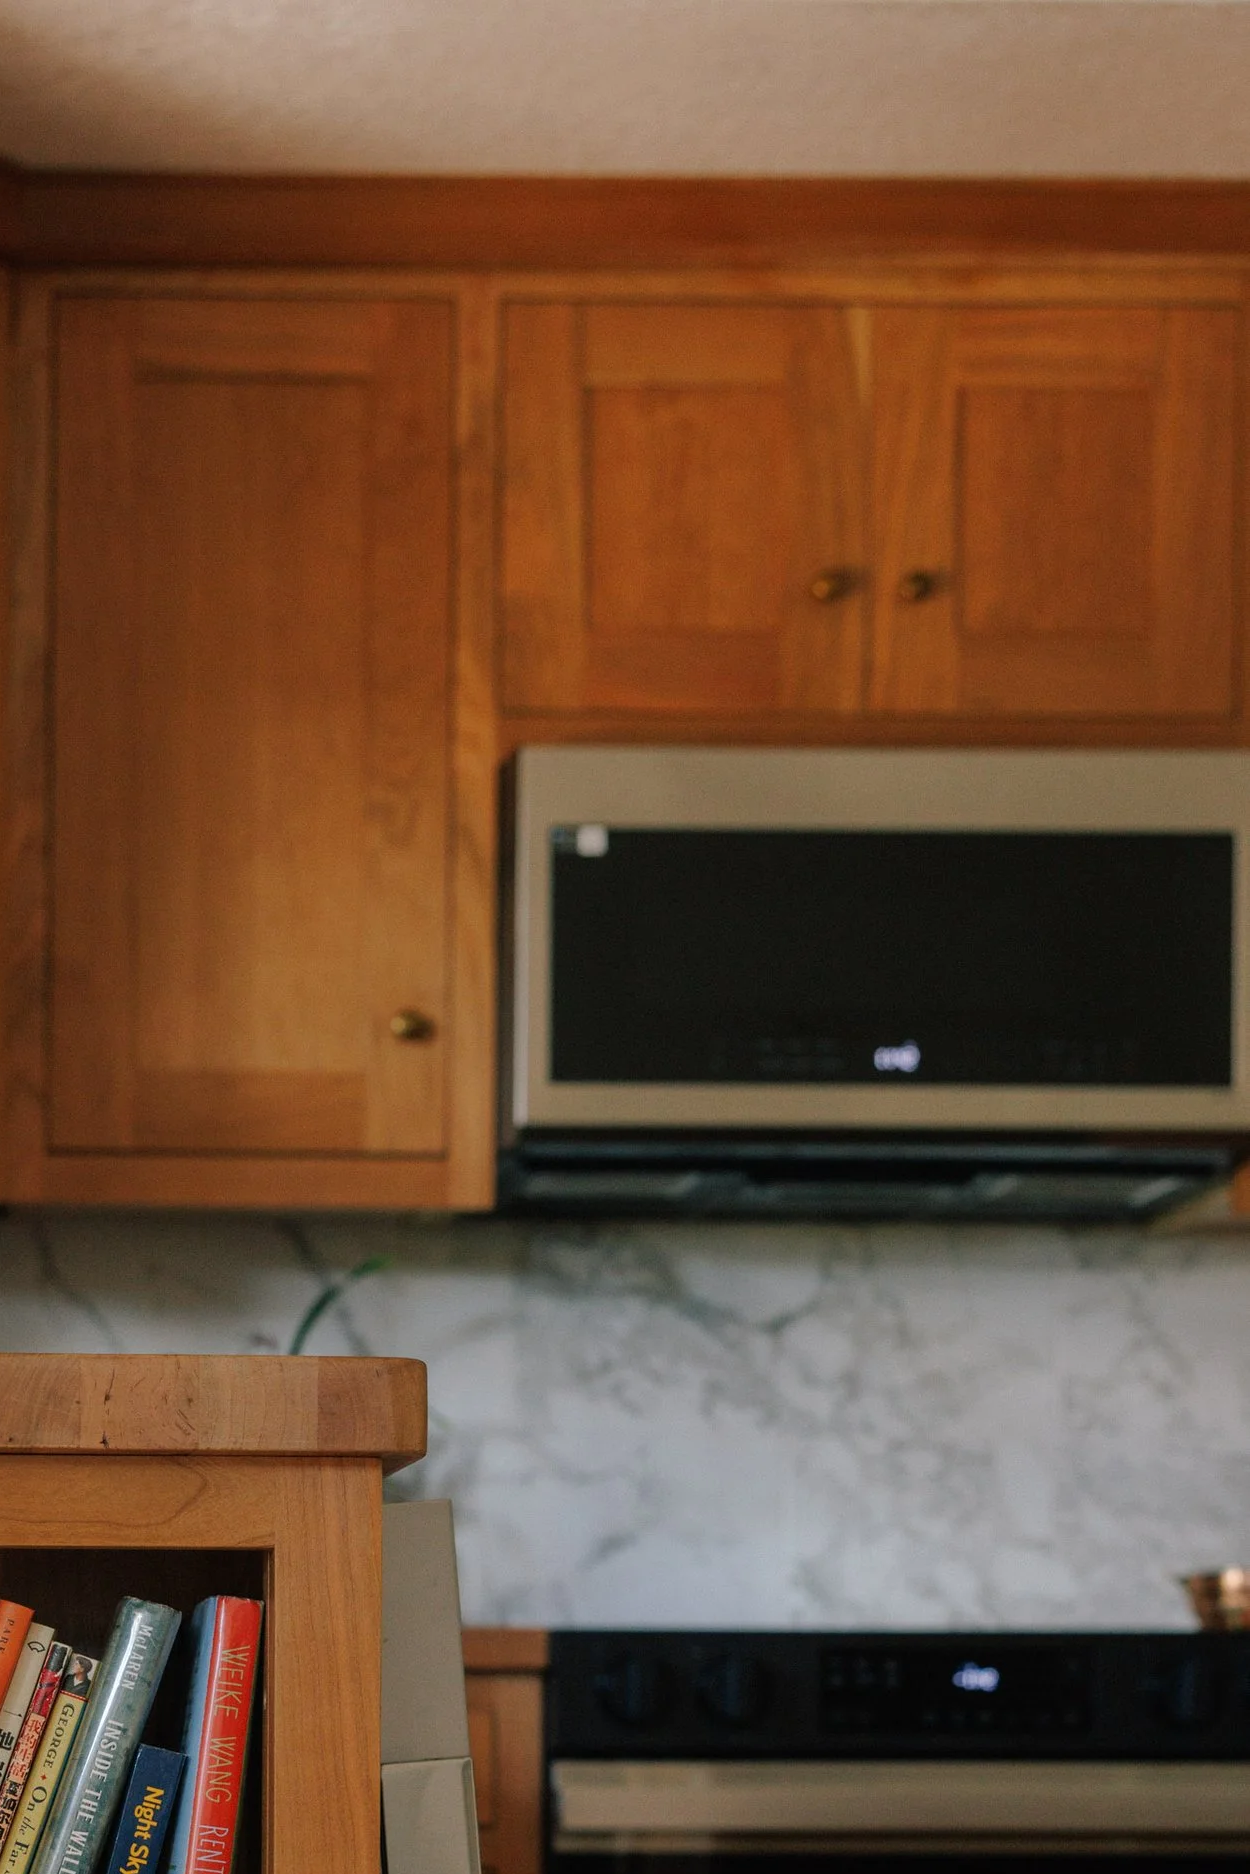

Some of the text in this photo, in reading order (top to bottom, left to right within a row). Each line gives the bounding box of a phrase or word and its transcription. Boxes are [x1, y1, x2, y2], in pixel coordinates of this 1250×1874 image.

[121, 1624, 154, 1691] McLAREN
[44, 1702, 75, 1769] GEORGE
[89, 1720, 124, 1782] INSIDE
[205, 1645, 250, 1804] WEIKE WANG
[19, 1816, 35, 1836] the
[27, 1786, 47, 1812] On
[76, 1789, 102, 1825] THE
[134, 1785, 165, 1840] Night
[9, 1840, 29, 1867] Far
